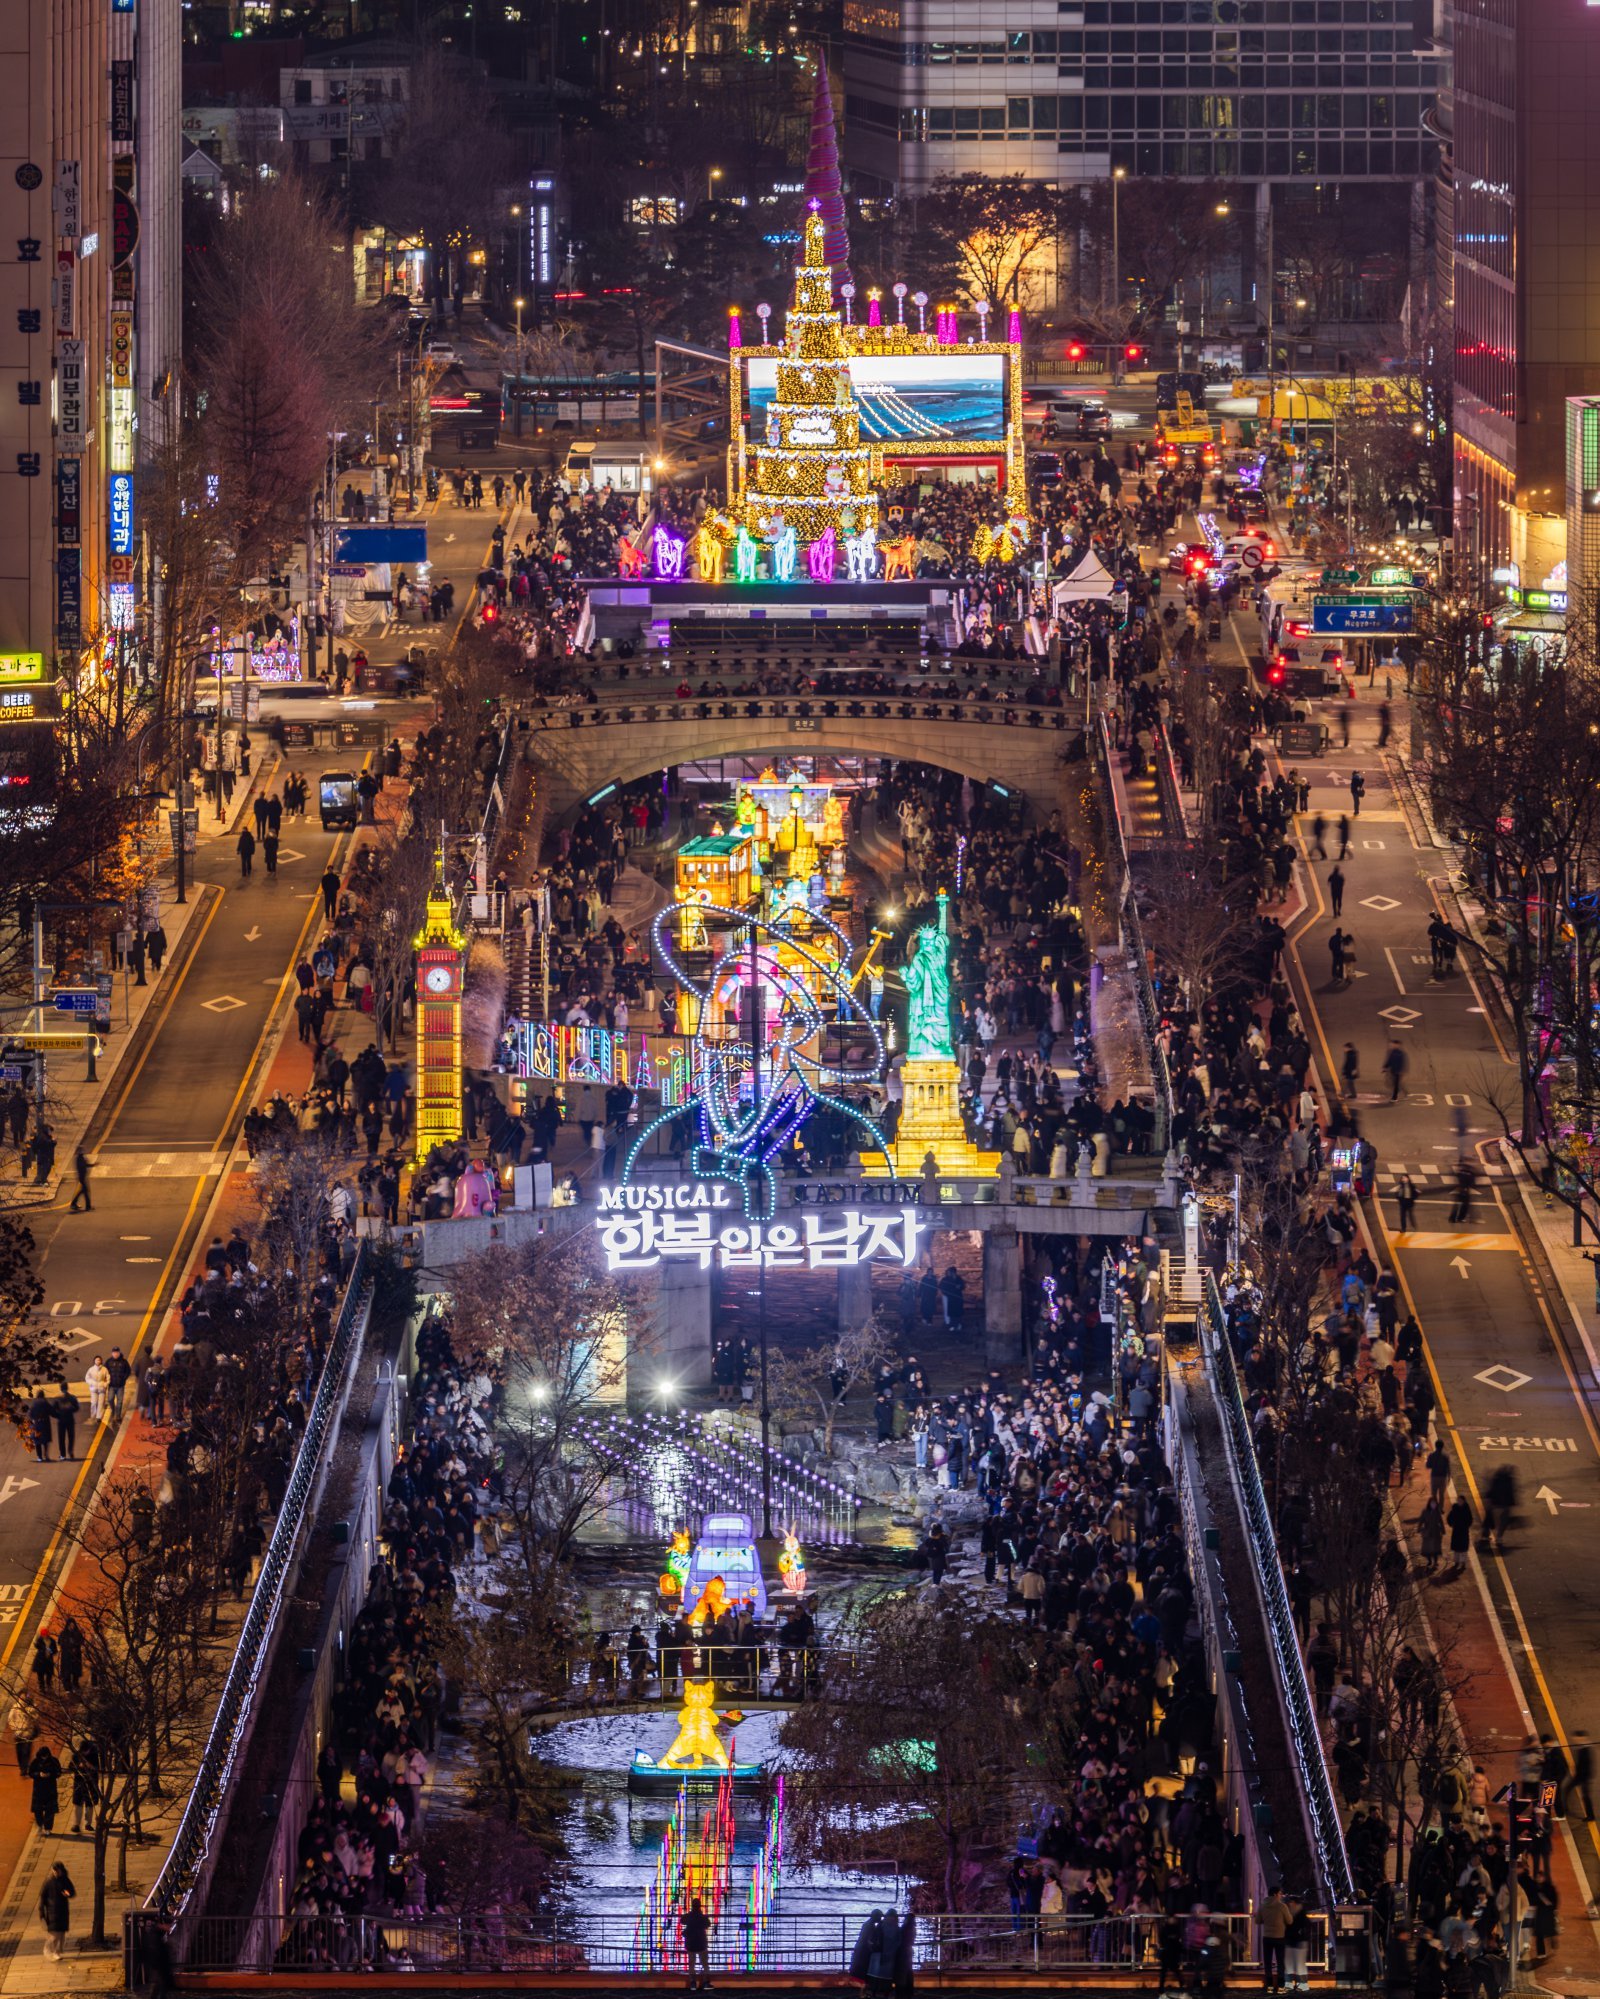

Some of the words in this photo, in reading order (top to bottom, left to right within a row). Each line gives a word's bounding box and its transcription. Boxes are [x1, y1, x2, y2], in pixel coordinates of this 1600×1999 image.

[115, 203, 130, 253] BAR
[62, 363, 81, 434] 피부관리
[61, 480, 78, 541] 남산집
[113, 511, 130, 545] 내과
[1550, 593, 1567, 608] CU
[1349, 610, 1376, 619] 무교로
[3, 694, 31, 706] BEER
[0, 706, 34, 718] COFFEE
[1409, 1093, 1473, 1107] 30
[597, 1184, 731, 1210] MUSICAL
[1188, 1207, 1195, 1216] 3
[49, 1299, 127, 1317] 30
[1477, 1436, 1578, 1452] 천천히
